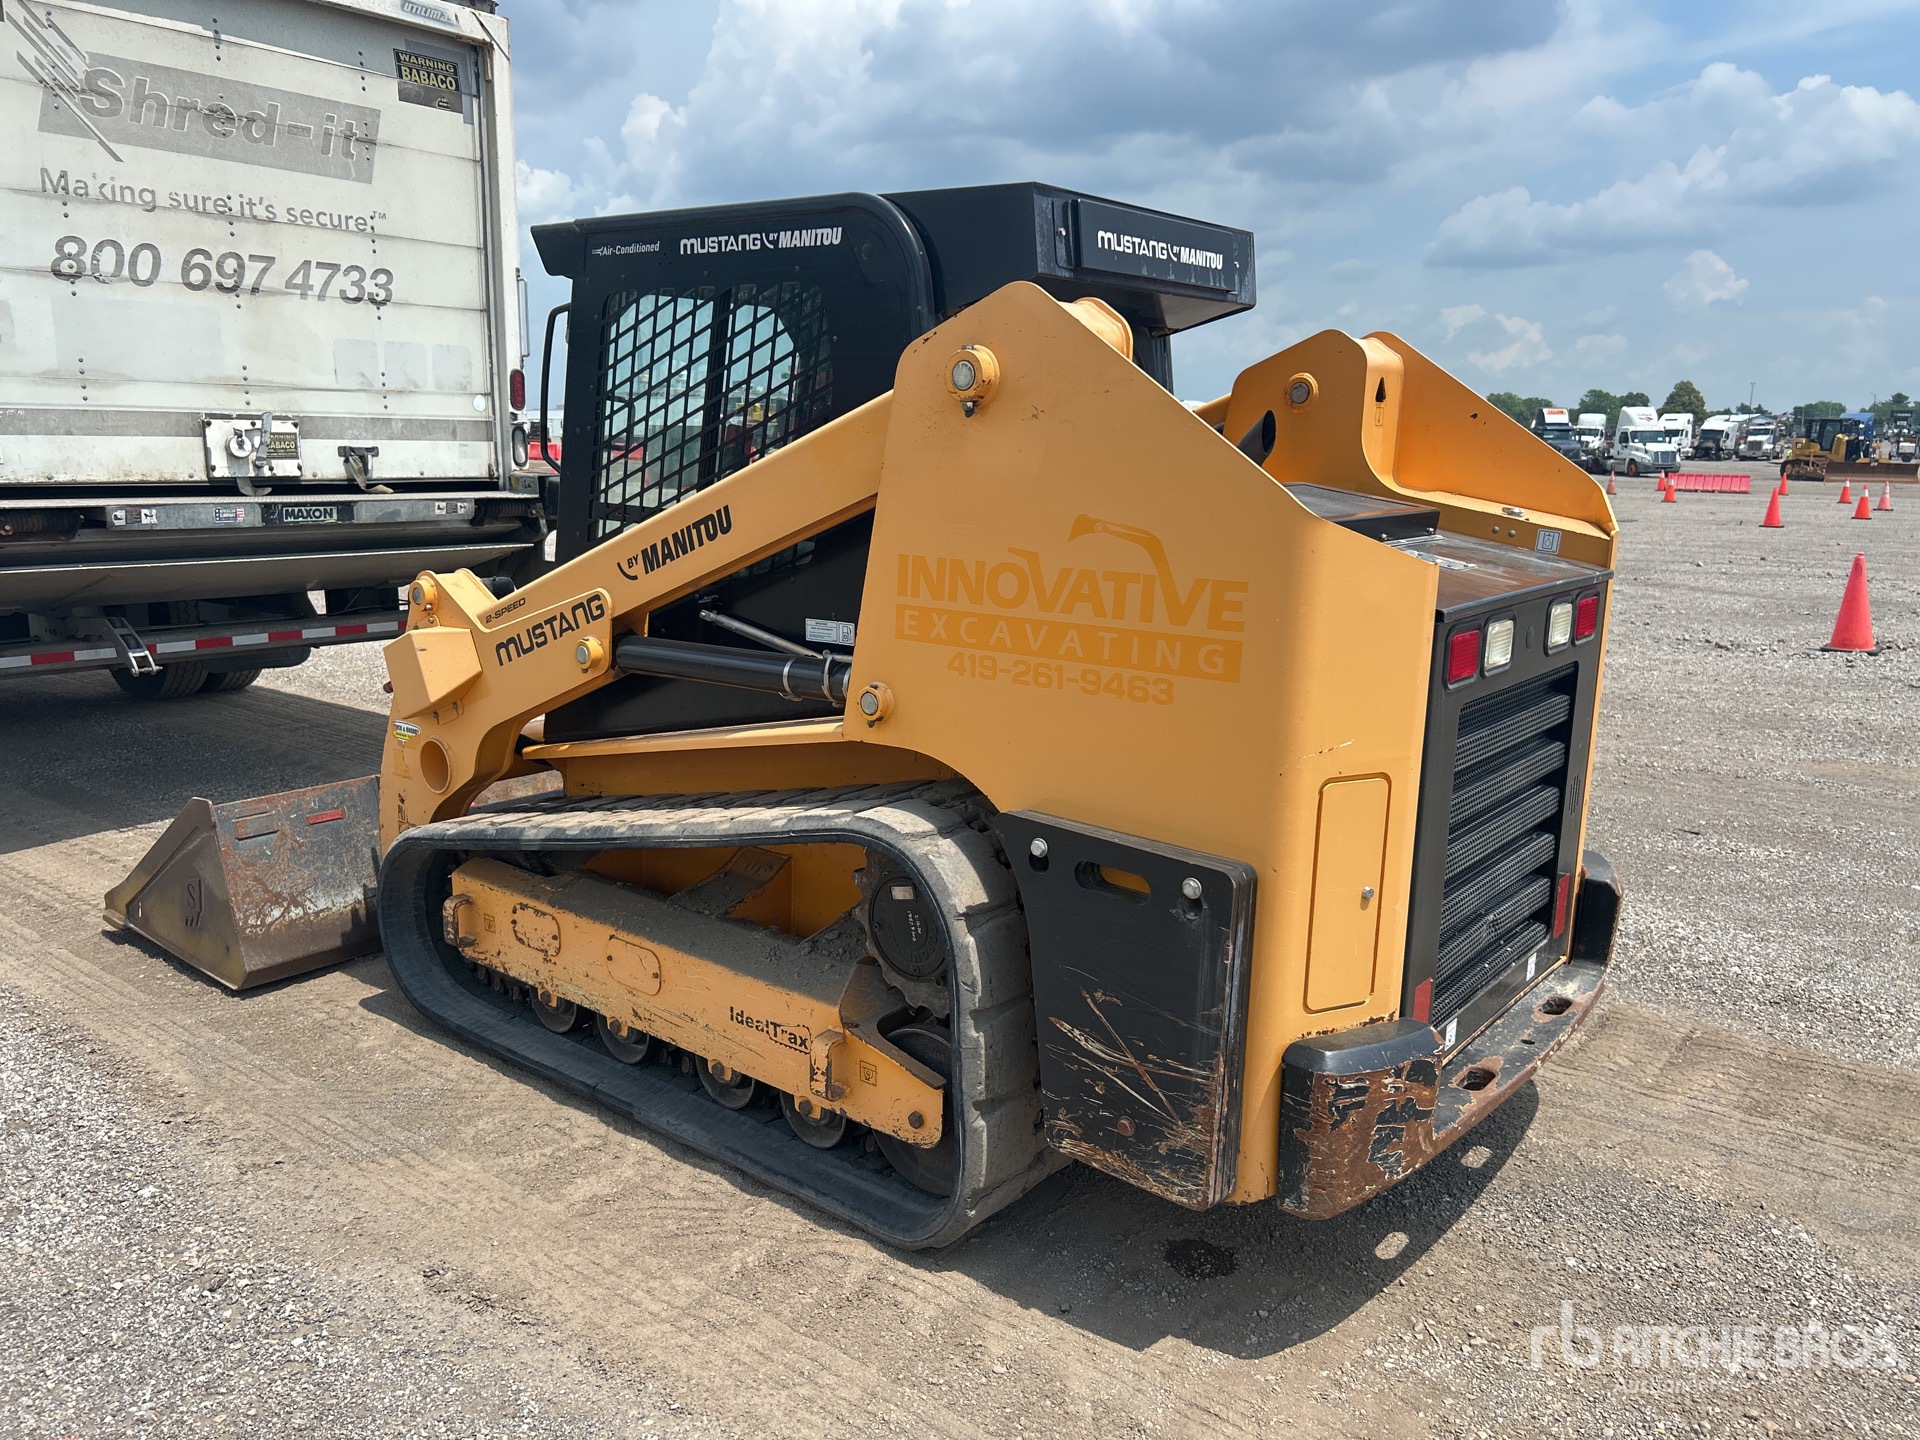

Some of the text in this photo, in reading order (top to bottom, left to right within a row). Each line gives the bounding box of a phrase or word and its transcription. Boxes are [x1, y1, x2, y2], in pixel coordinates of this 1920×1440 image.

[399, 53, 455, 73] WARNING
[401, 66, 456, 91] BABACO
[79, 66, 359, 161] Shred-it
[39, 167, 157, 213] Making
[168, 191, 229, 215] sure
[238, 193, 278, 221] it's
[602, 226, 843, 257] Air-Conditioned MUSTANG BY MANITOU
[1097, 230, 1224, 270] MUSTANG BY MANITOU
[50, 235, 394, 307] 800 697 4733
[268, 441, 296, 449] ABACO
[284, 507, 334, 520] MAXON
[627, 504, 733, 575] BY MANITOU
[485, 596, 526, 624] 2-SPEED
[896, 547, 1250, 633] INNOVATIVE
[495, 593, 605, 667] MUSTANG
[903, 610, 1225, 675] EXCAVATING
[946, 651, 1175, 706] 419-261-9463
[729, 1005, 809, 1050] IdealTrax
